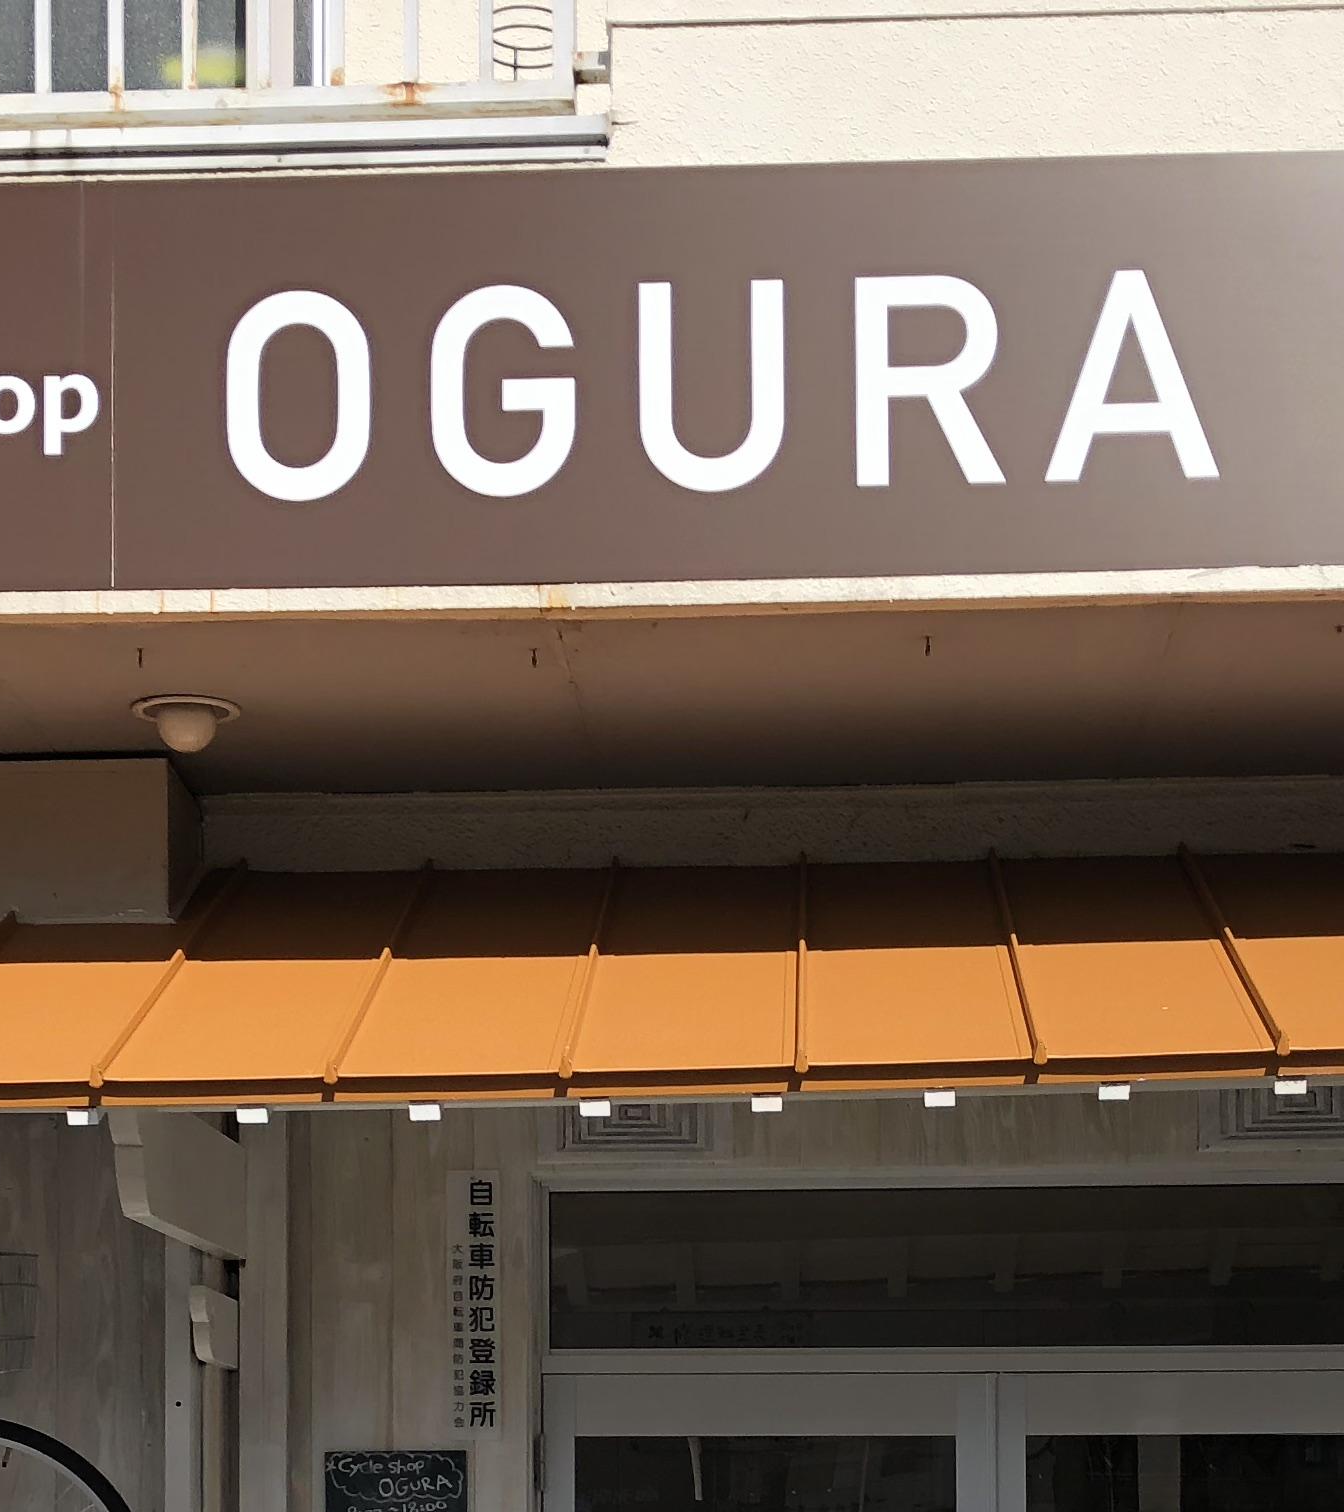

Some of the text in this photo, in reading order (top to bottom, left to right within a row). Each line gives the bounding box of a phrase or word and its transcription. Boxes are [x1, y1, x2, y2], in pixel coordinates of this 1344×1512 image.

[226, 269, 1220, 502] OGURA
[468, 1179, 496, 1429] 自転車防犯登録所
